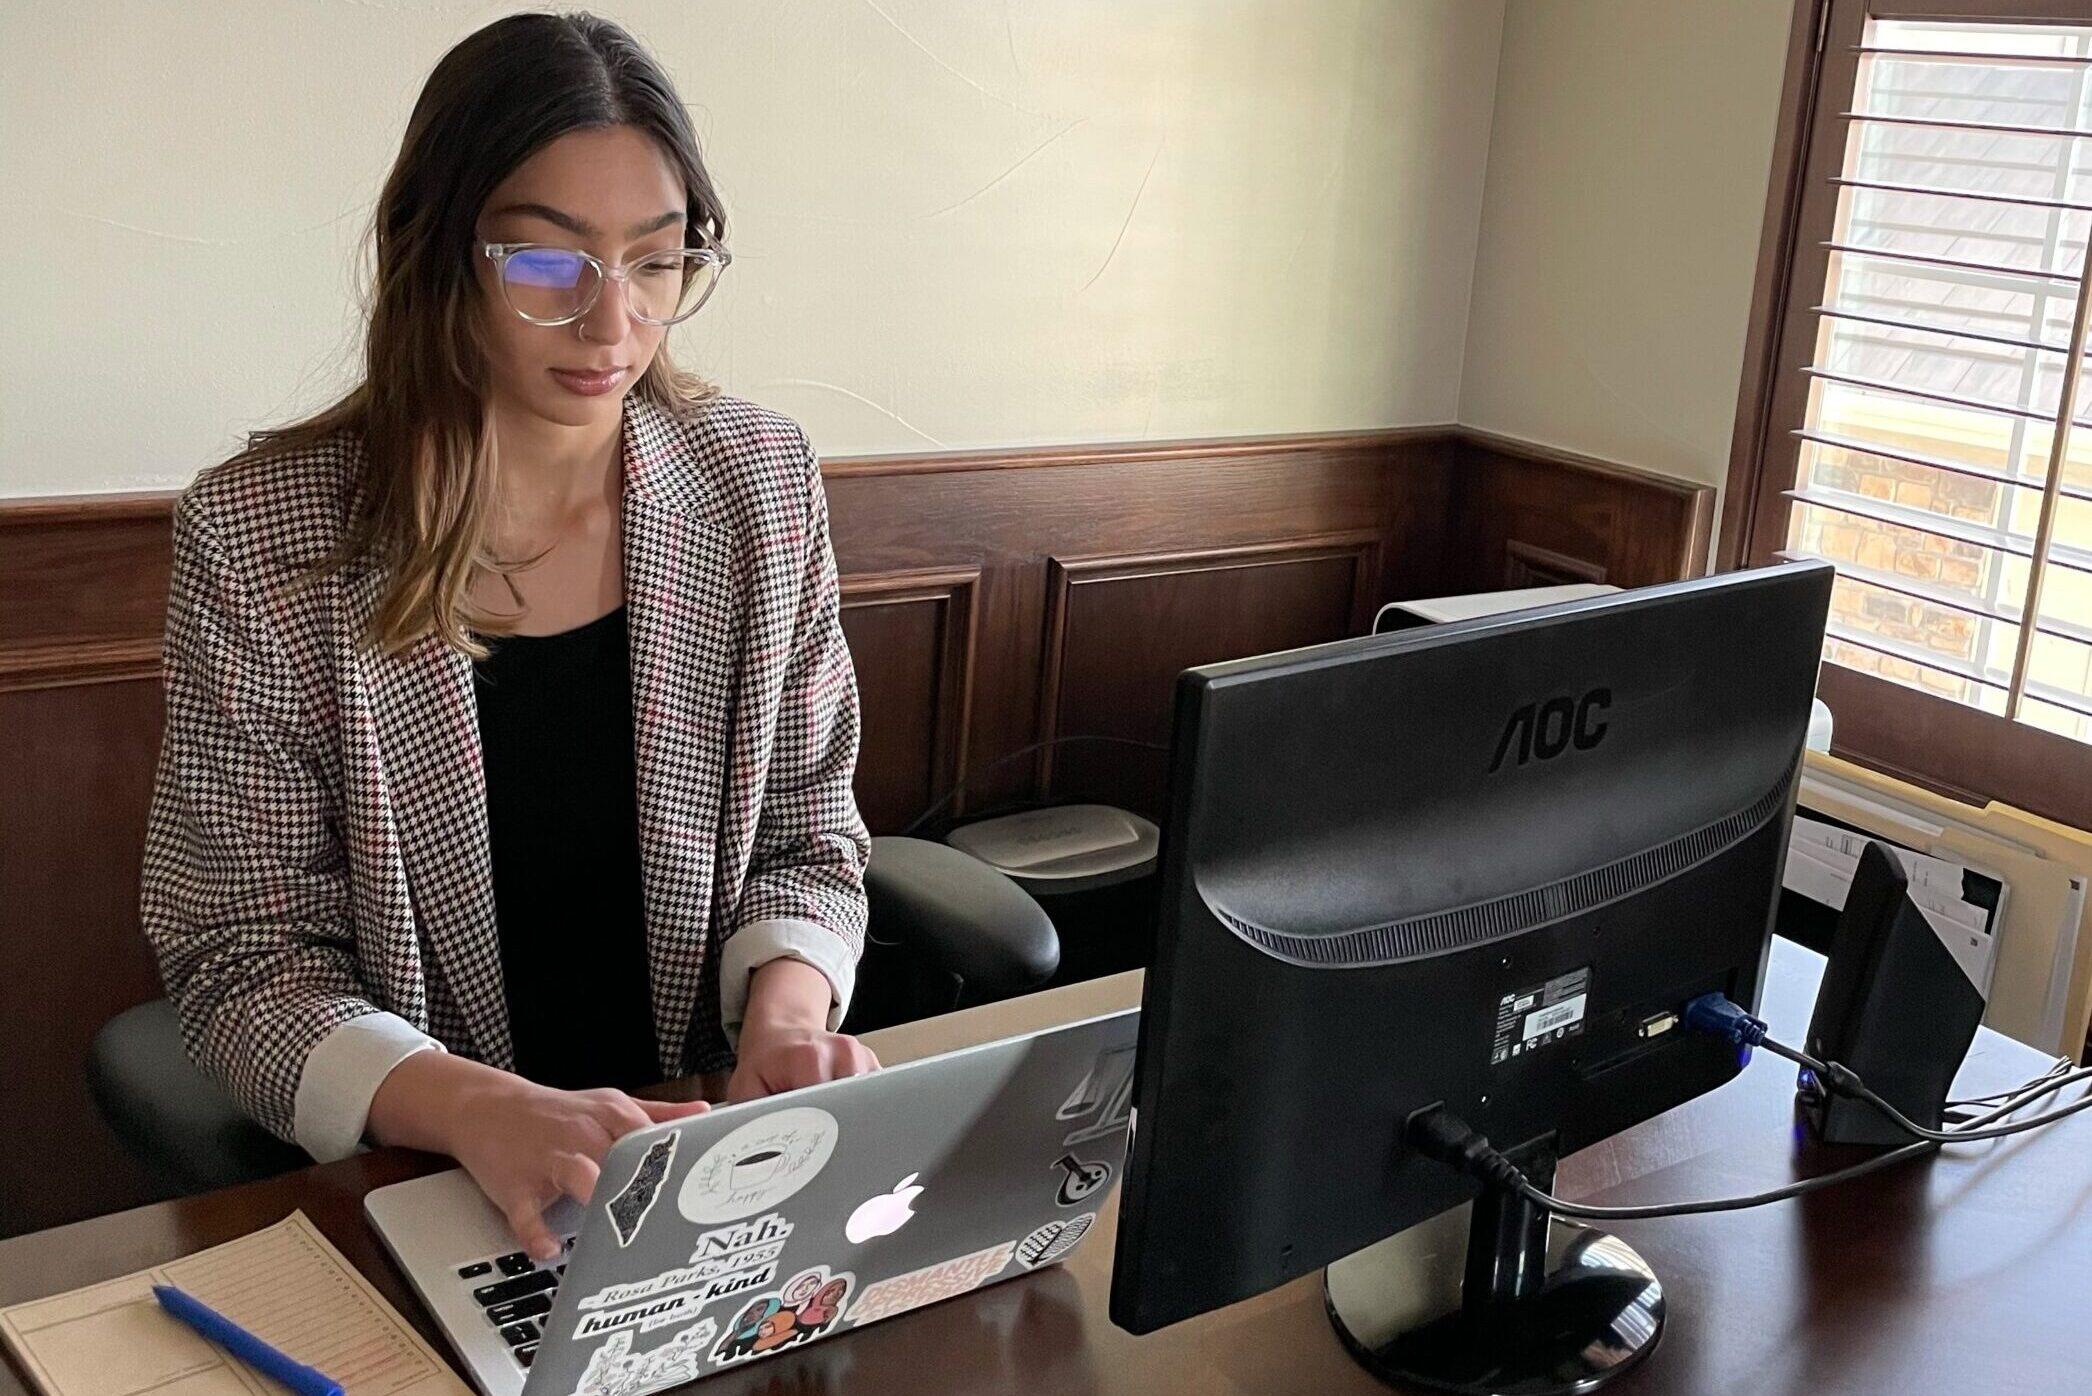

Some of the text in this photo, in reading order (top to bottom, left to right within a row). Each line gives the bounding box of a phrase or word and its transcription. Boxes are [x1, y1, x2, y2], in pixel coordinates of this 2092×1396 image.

[1488, 688, 1612, 774] AOC
[699, 1220, 787, 1257] Nah.
[582, 1297, 686, 1334] human
[705, 1266, 771, 1299] kind
[603, 1283, 654, 1303] Rosa
[661, 1265, 720, 1288] Parks,
[730, 1245, 779, 1268] 1955
